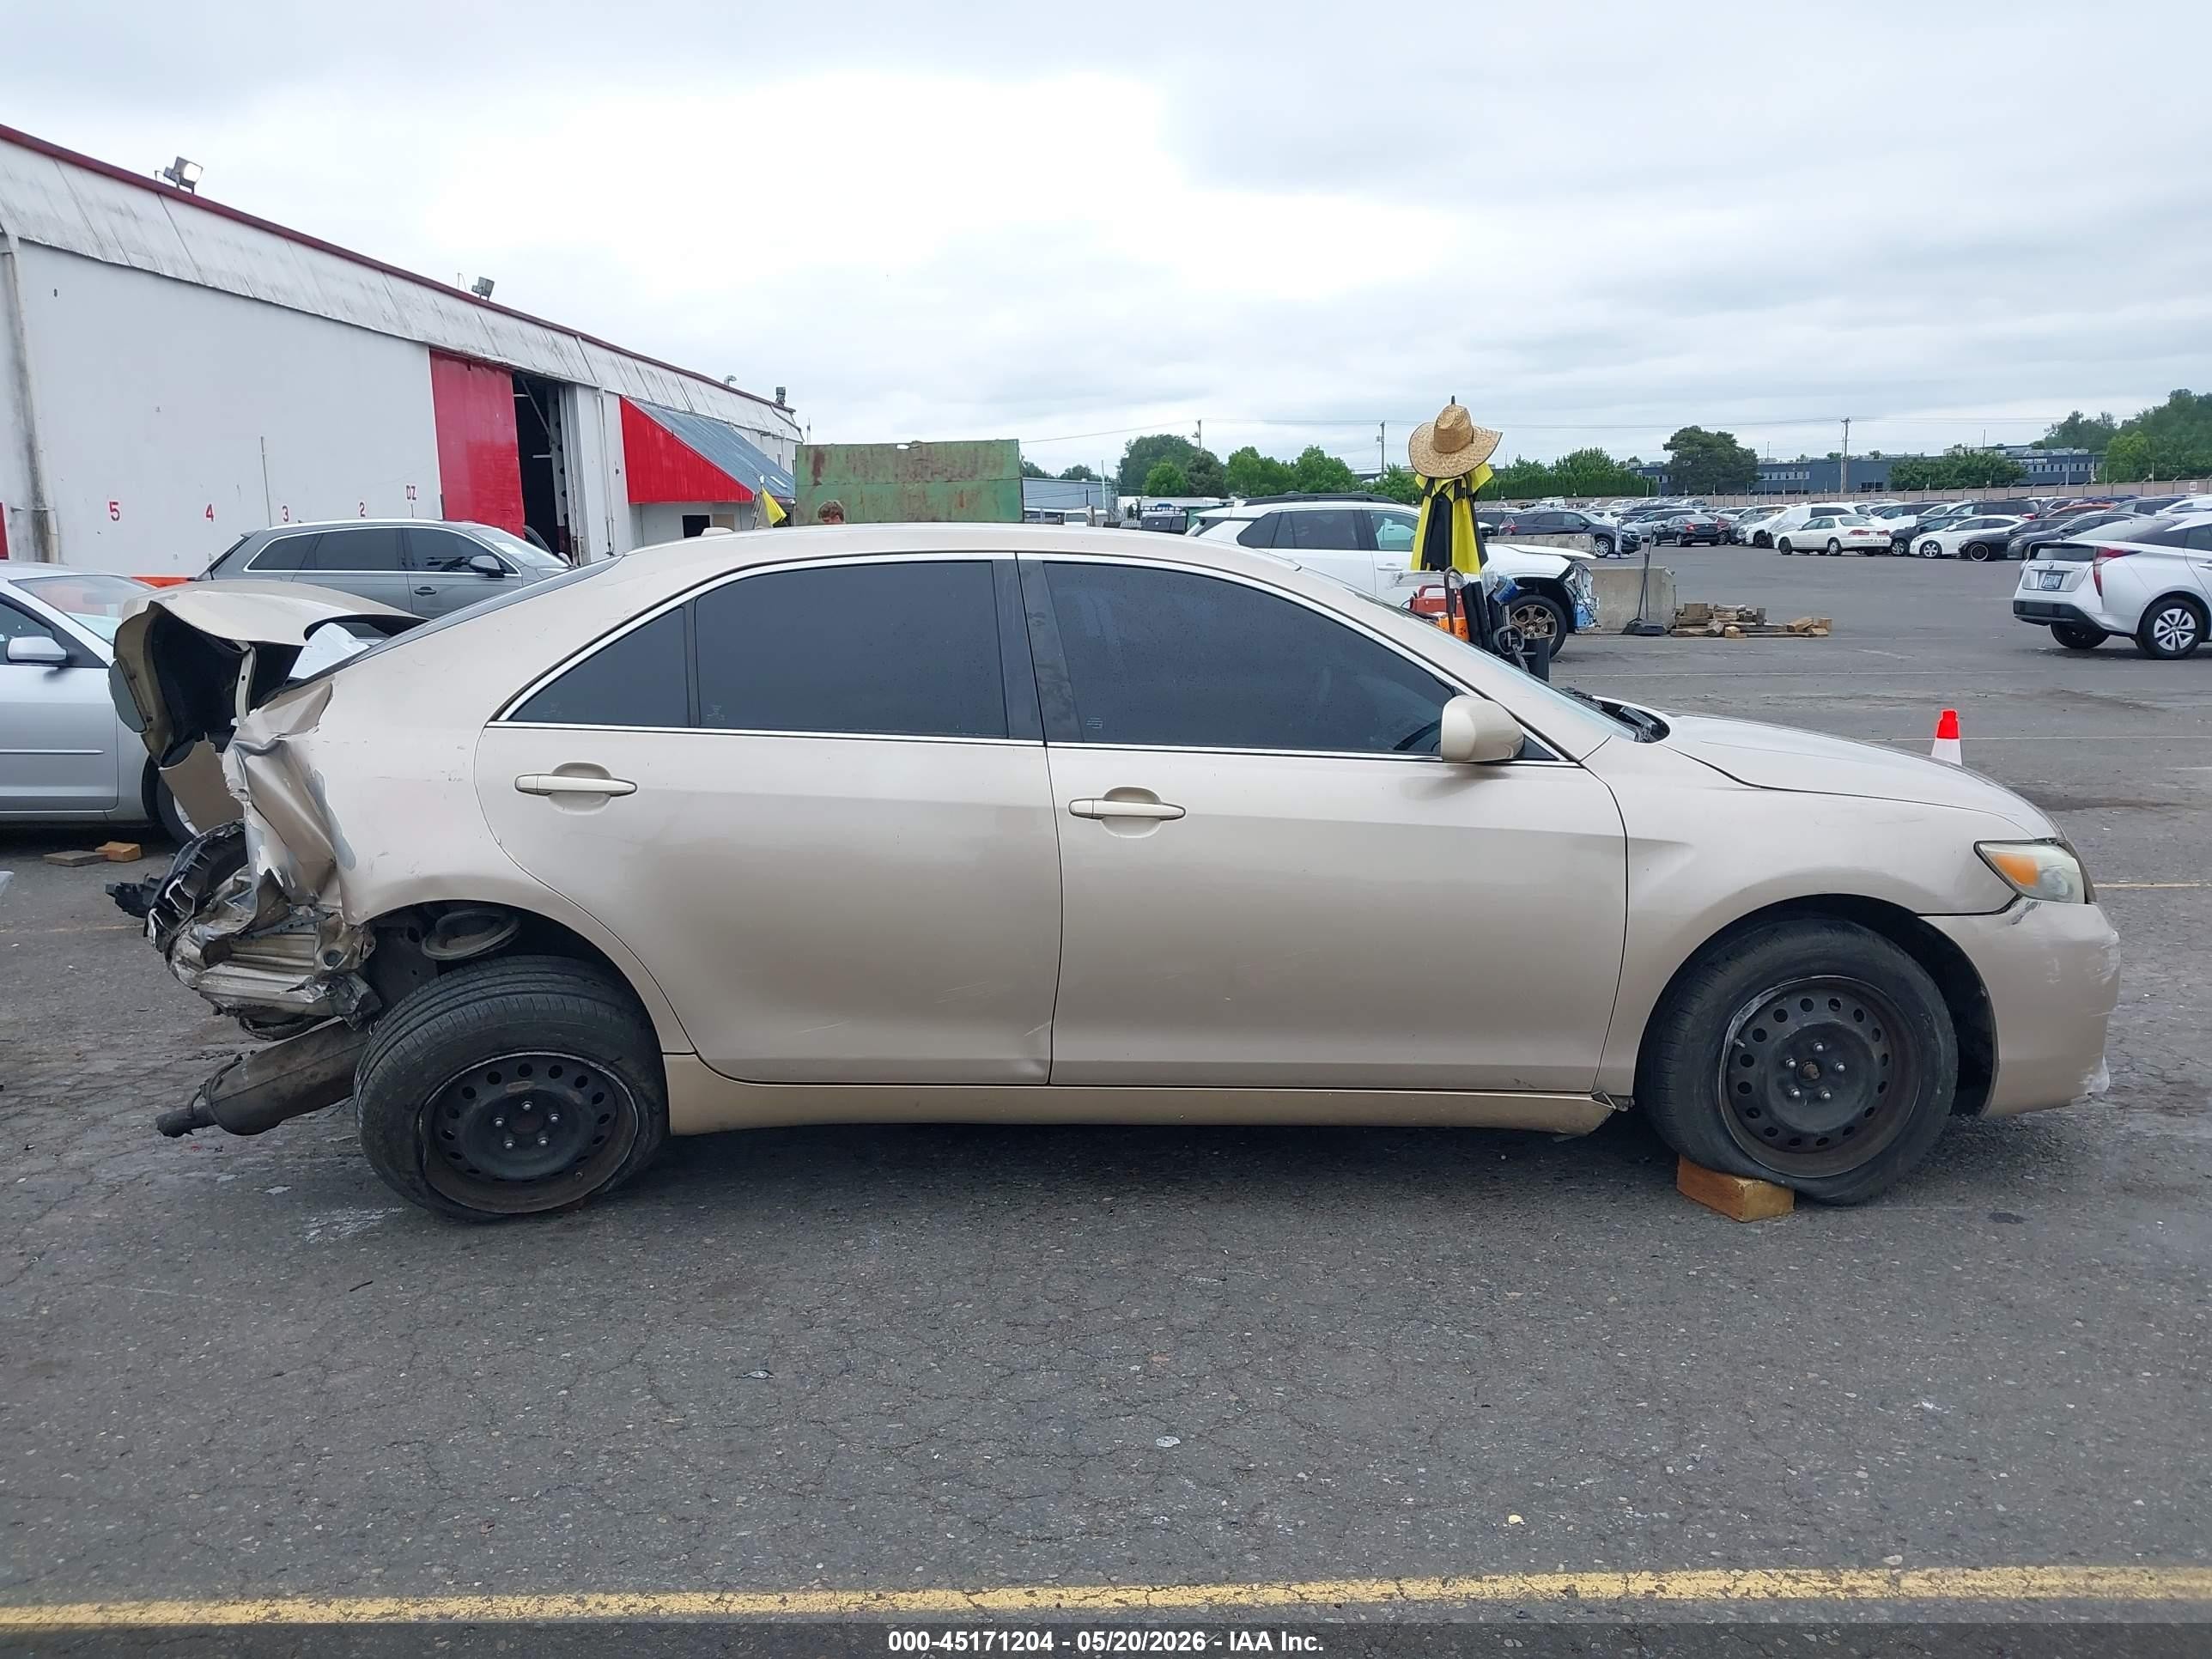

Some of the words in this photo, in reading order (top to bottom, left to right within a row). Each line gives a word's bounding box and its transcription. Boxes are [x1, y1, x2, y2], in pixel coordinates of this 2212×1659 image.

[109, 501, 120, 522] 5
[205, 502, 215, 523] 4
[282, 505, 289, 523] 3
[359, 501, 366, 518] 2
